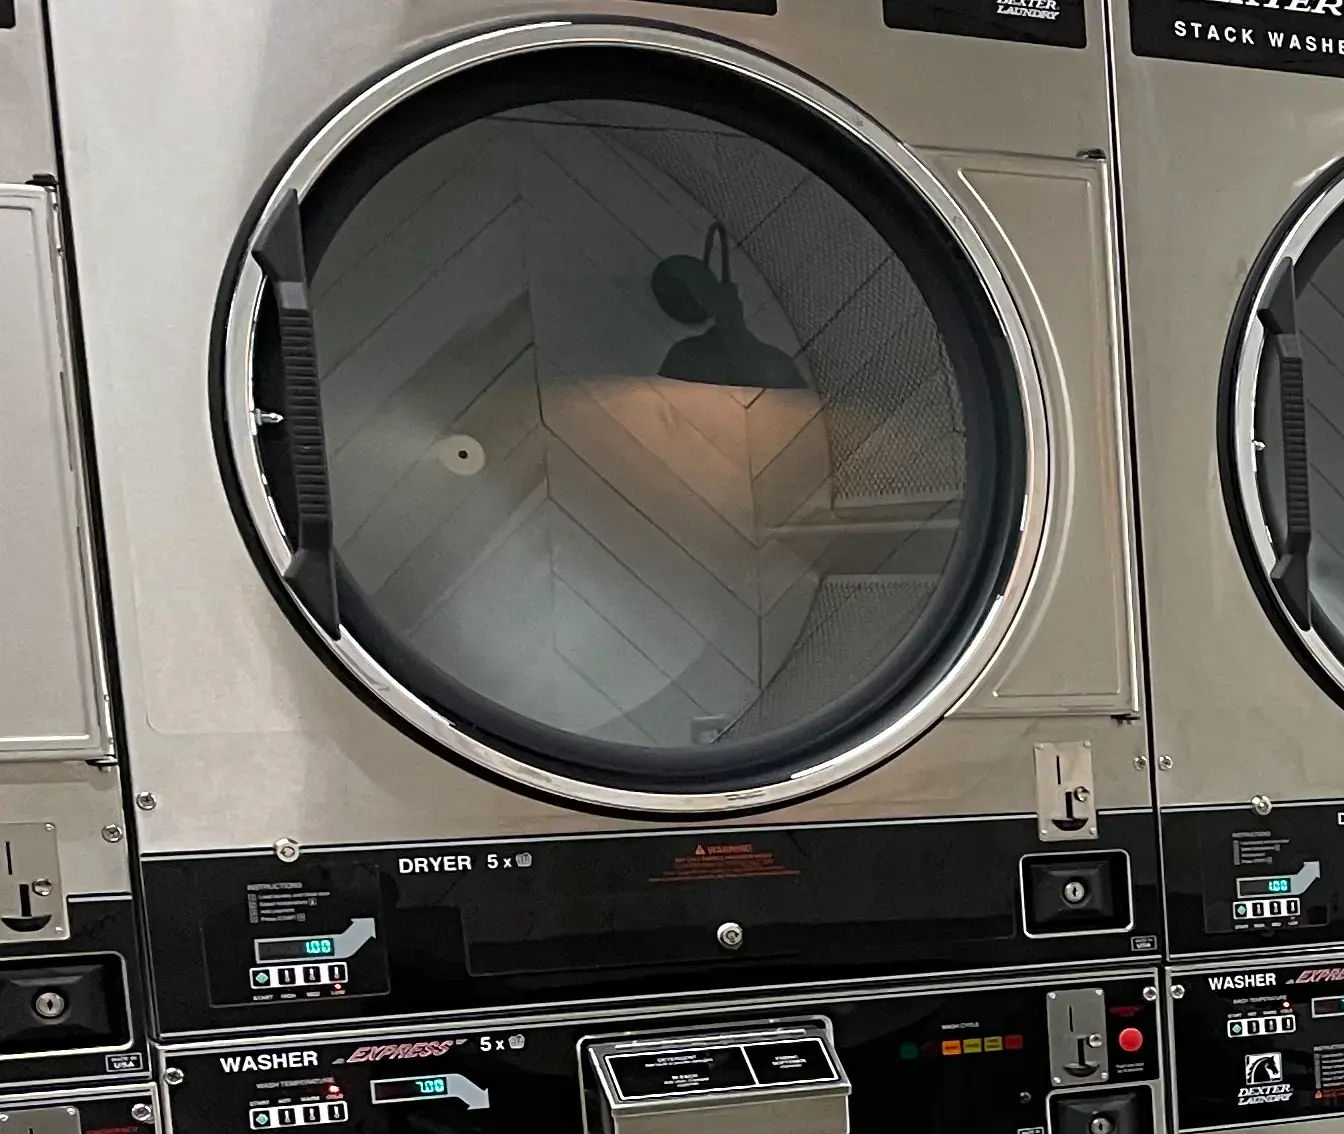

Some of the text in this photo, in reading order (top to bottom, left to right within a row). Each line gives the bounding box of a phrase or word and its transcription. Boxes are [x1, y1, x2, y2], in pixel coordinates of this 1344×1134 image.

[997, 5, 1059, 20] LAUNDRY
[1174, 20, 1254, 45] STACK
[399, 854, 512, 874] DRYER 5 x
[1208, 972, 1277, 990] WASHER
[220, 1037, 504, 1073] WASHER EXPRESS 5 x
[114, 1061, 135, 1069] USA
[1238, 1084, 1291, 1098] DEXTER
